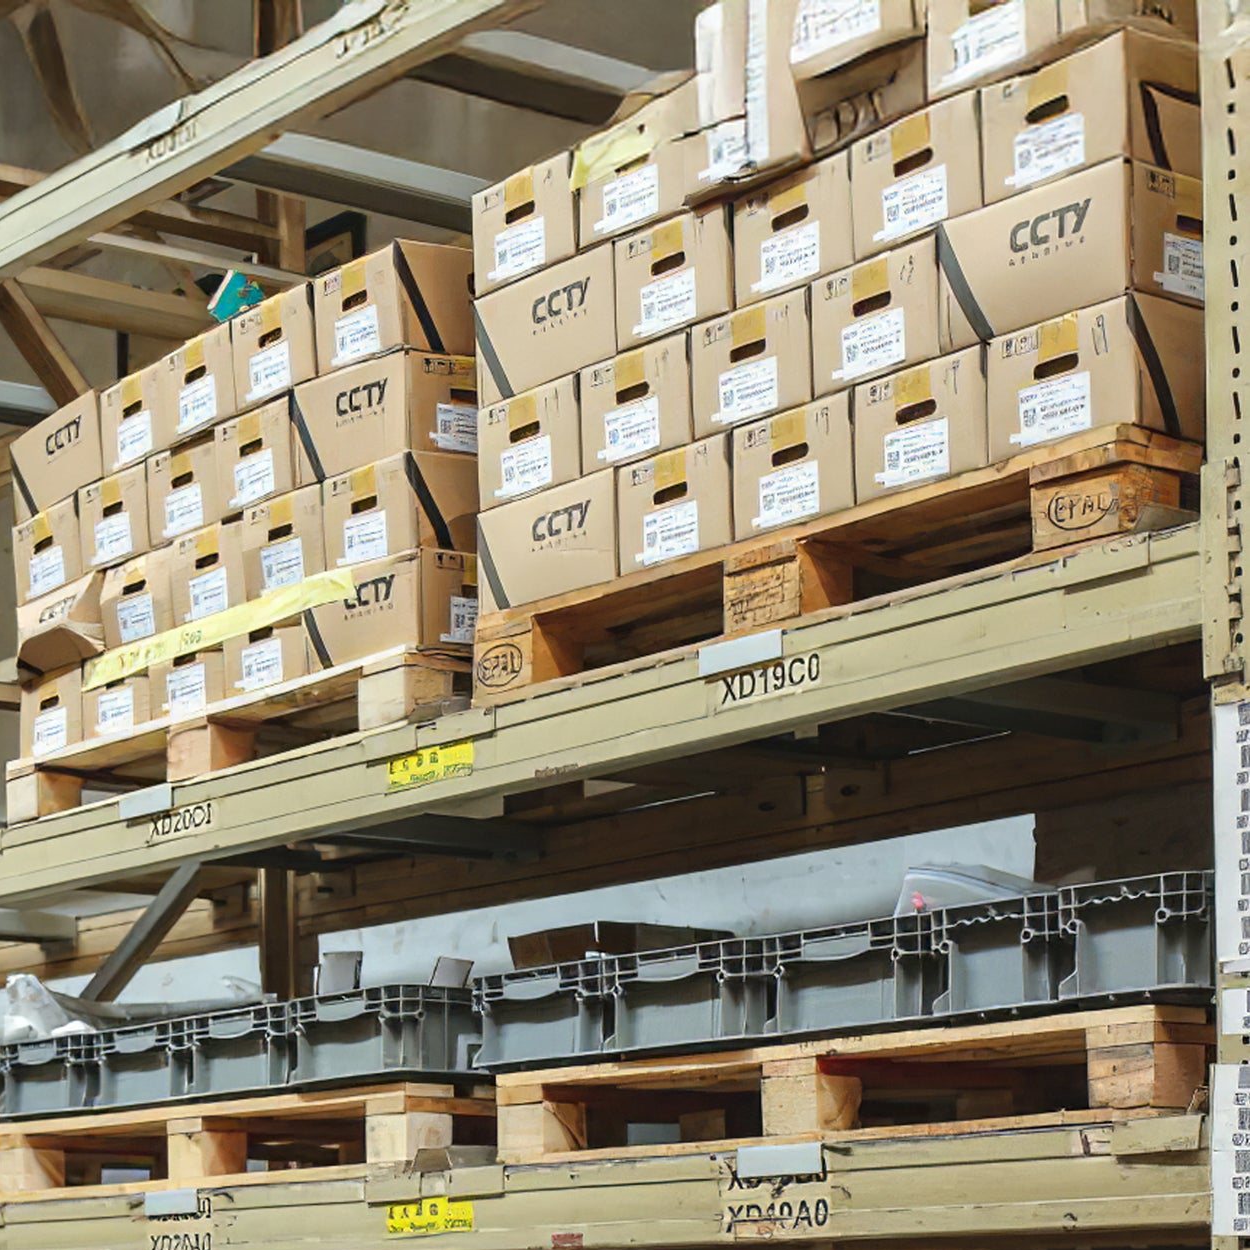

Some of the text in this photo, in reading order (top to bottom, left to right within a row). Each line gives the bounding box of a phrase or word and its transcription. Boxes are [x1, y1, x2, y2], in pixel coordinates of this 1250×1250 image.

[1009, 198, 1092, 253] CCTY
[532, 276, 591, 324] CCTY
[336, 377, 388, 417] CCTY
[45, 414, 82, 456] CCTY
[532, 499, 592, 542] CCTY
[721, 653, 821, 705] XD19C0
